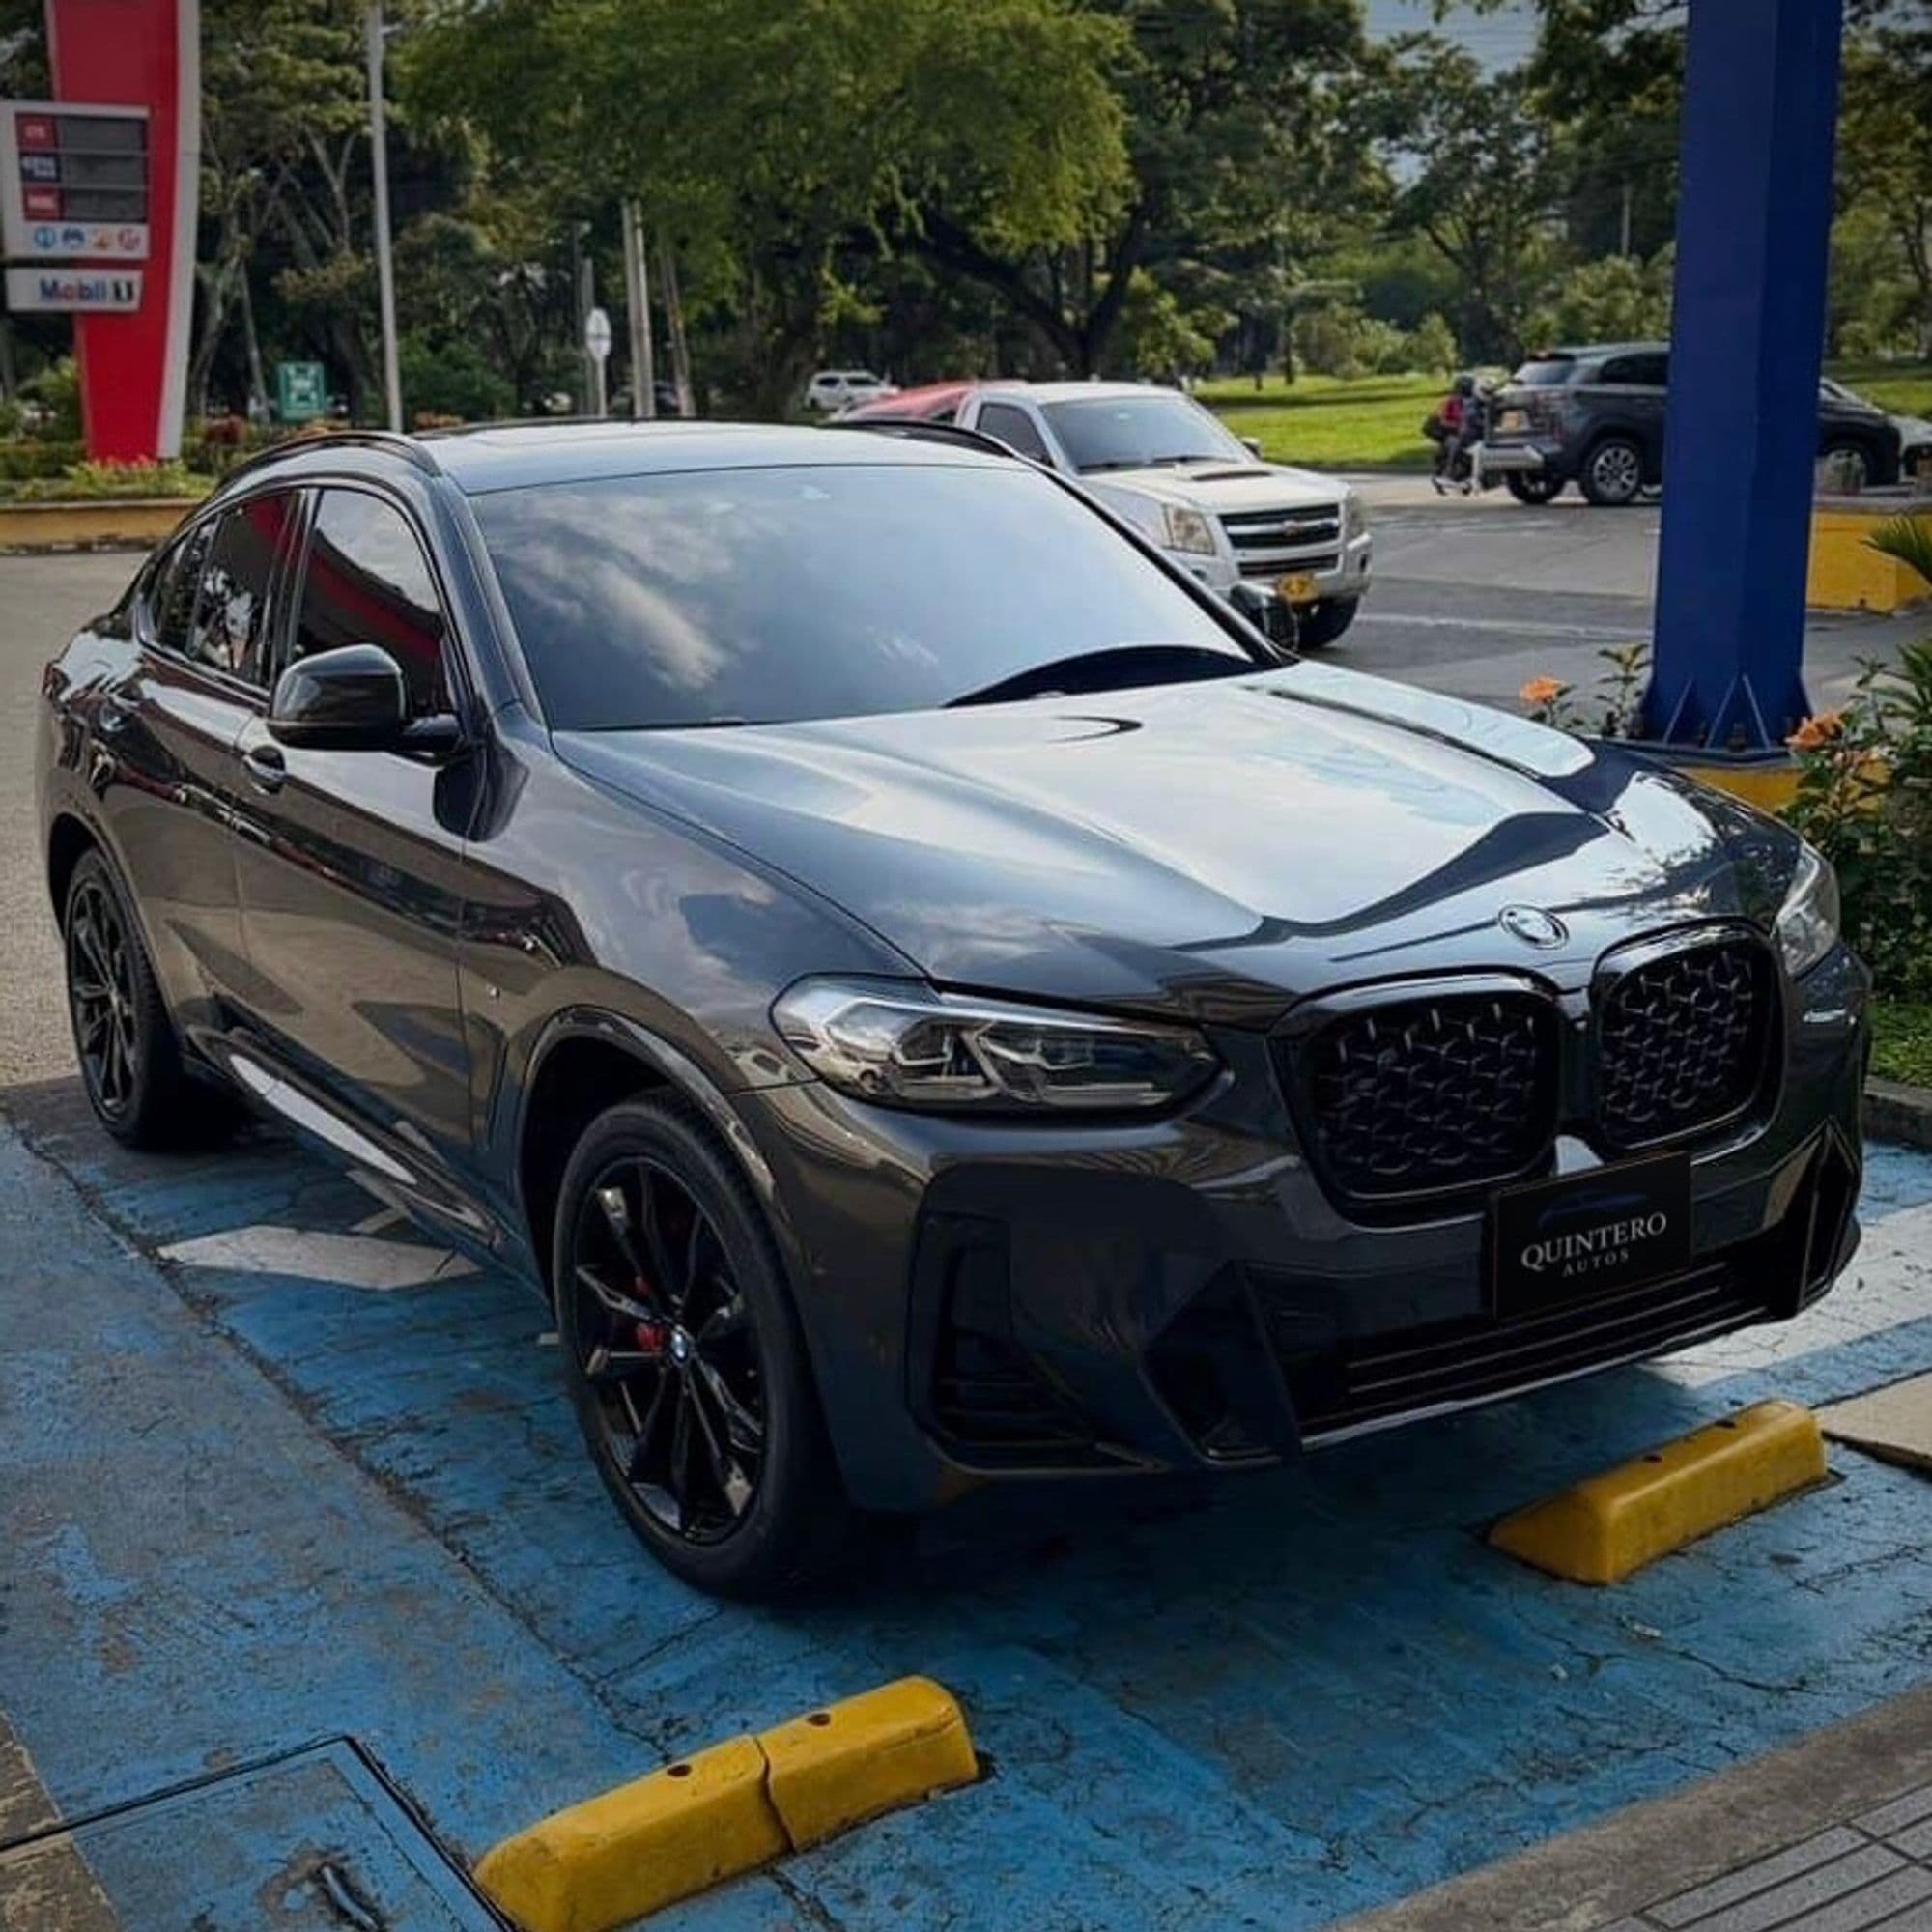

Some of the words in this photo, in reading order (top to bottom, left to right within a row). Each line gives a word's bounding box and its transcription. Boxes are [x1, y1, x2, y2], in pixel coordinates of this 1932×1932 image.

[40, 276, 107, 302] Mobil
[1520, 1211, 1667, 1271] QUINTERO
[1562, 1249, 1630, 1277] AUTOS
